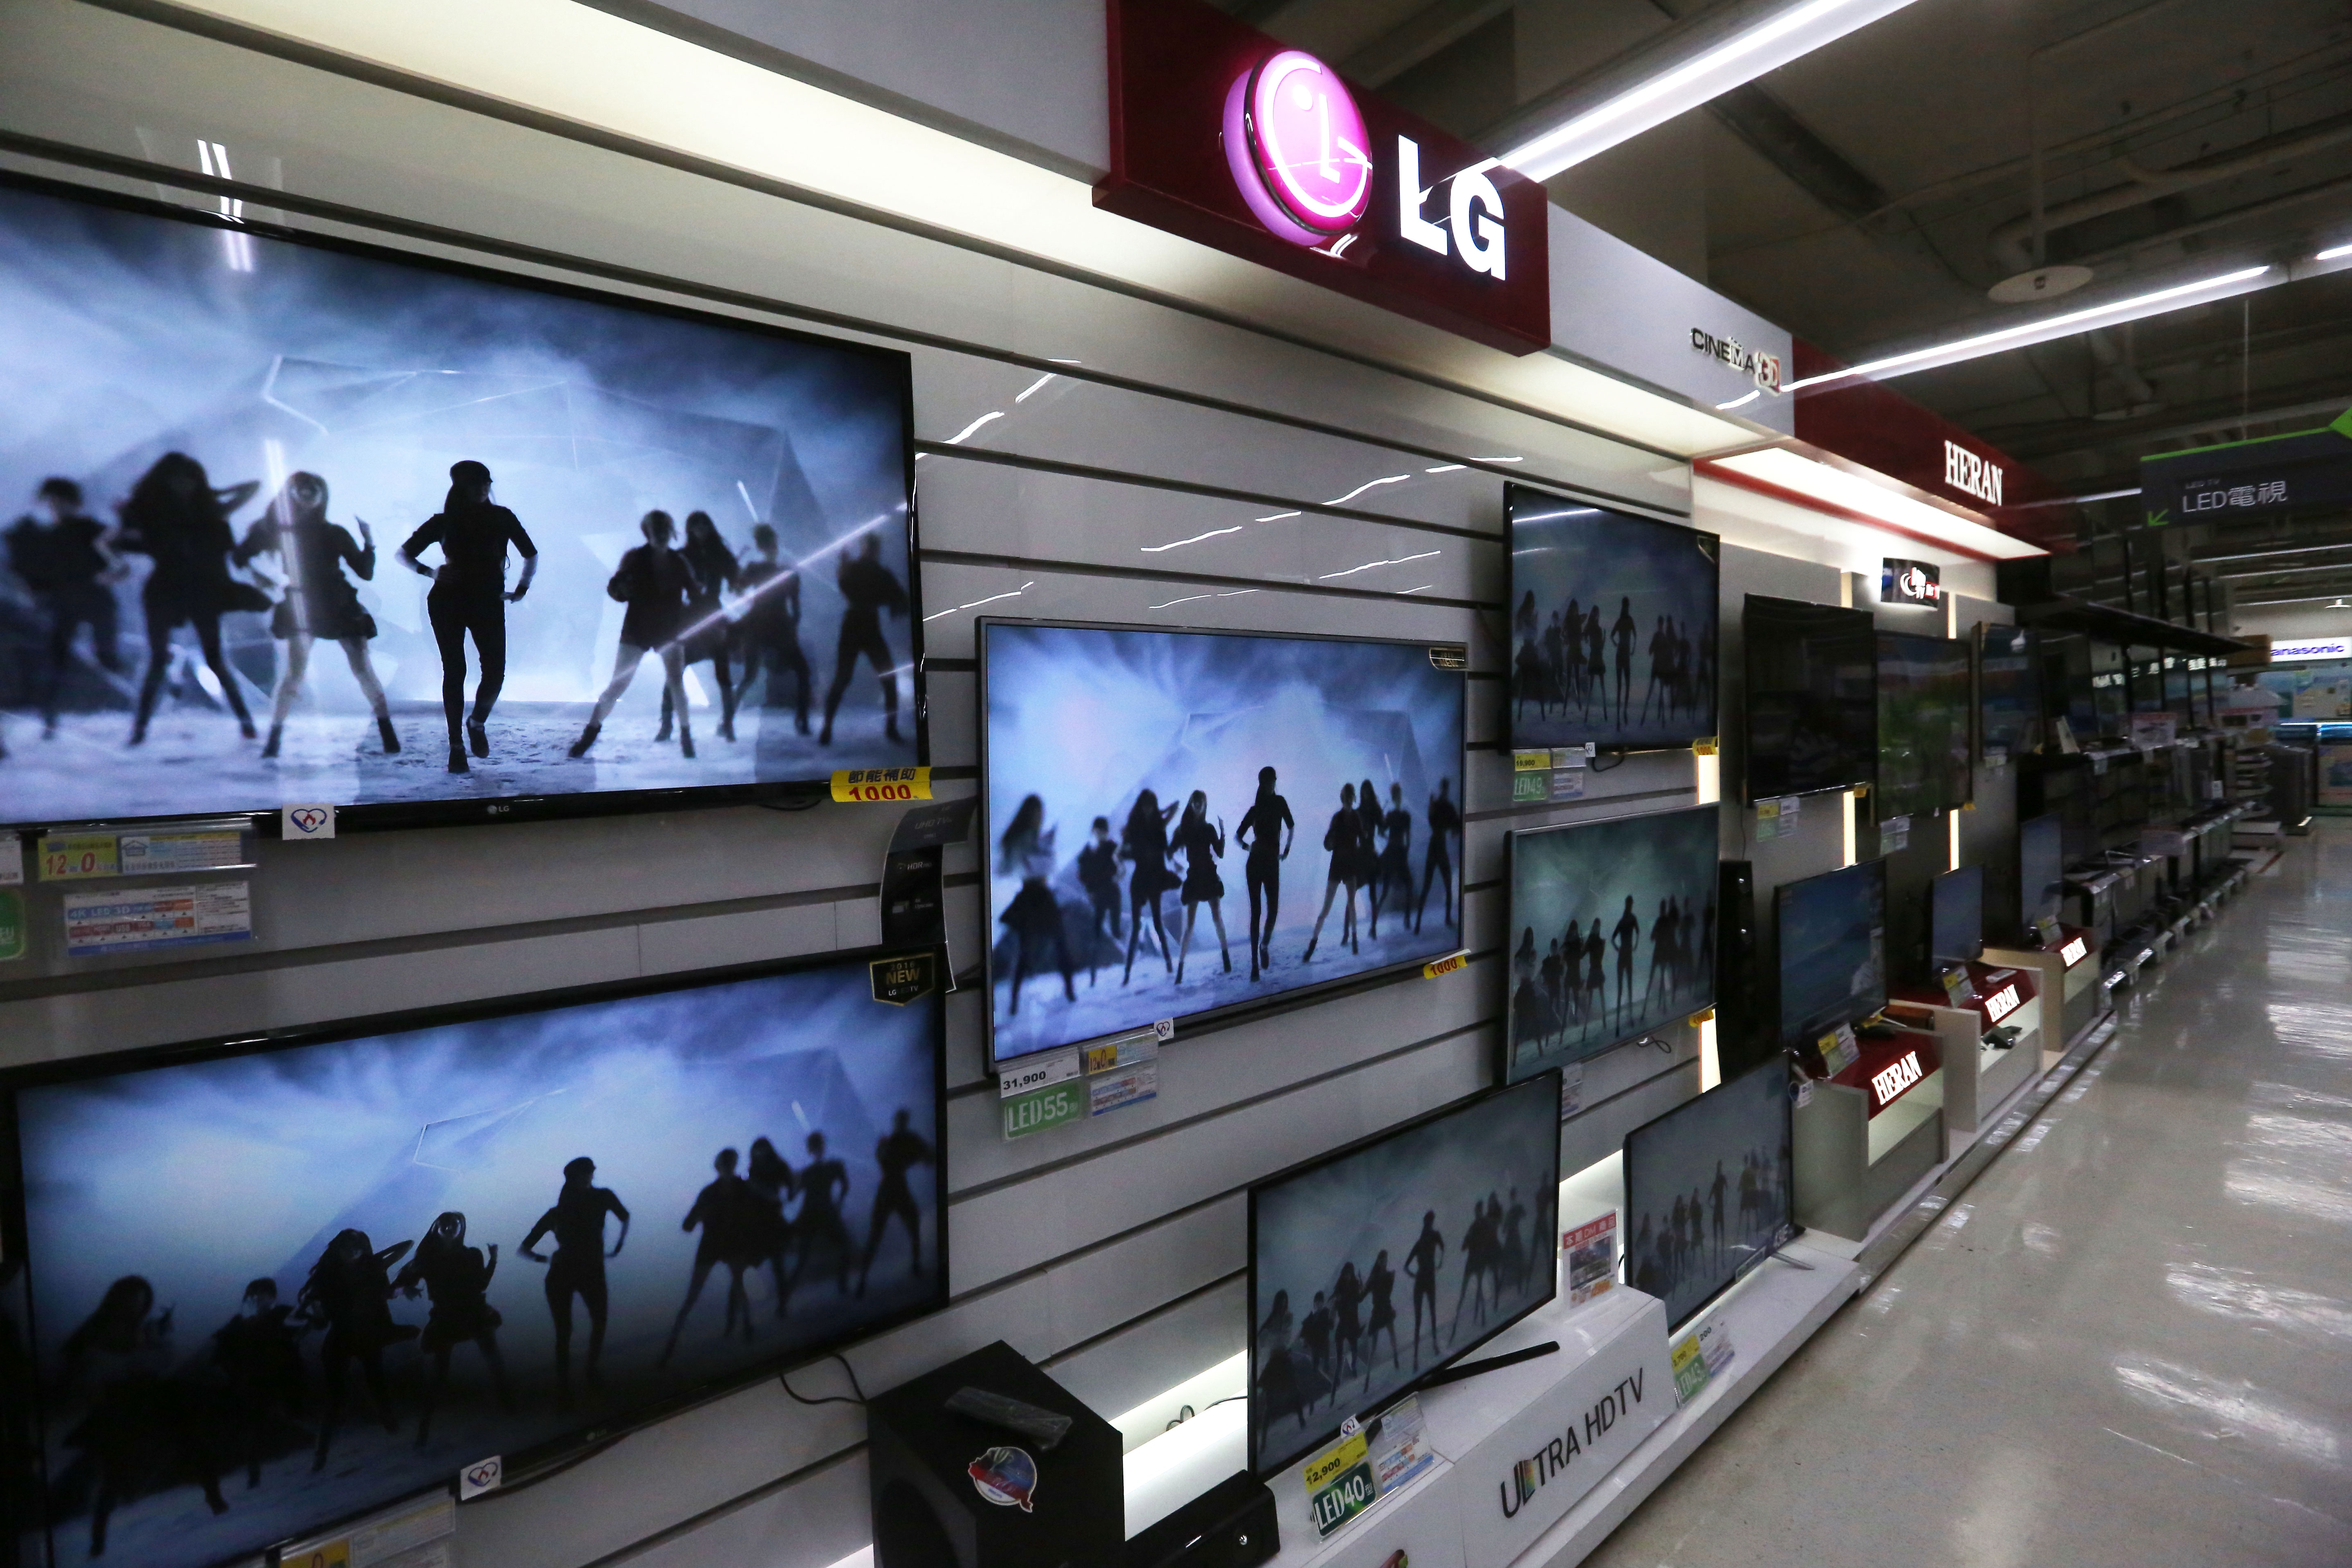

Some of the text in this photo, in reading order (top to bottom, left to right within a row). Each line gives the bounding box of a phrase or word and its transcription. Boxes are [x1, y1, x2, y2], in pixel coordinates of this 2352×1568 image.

[1399, 135, 1506, 281] LG
[1692, 328, 1755, 374] CINEMA
[1944, 440, 2002, 507] HERAN
[2183, 481, 2288, 513] LED電視
[2270, 644, 2344, 657] anasonic
[849, 784, 911, 801] 1000
[886, 968, 920, 985] NEW
[1430, 958, 1458, 976] 1000
[1003, 1071, 1046, 1090] 31,900
[1871, 1051, 1922, 1105] HERAN
[1501, 1426, 1581, 1519] ULTRA
[1585, 1367, 1643, 1446] HDTV
